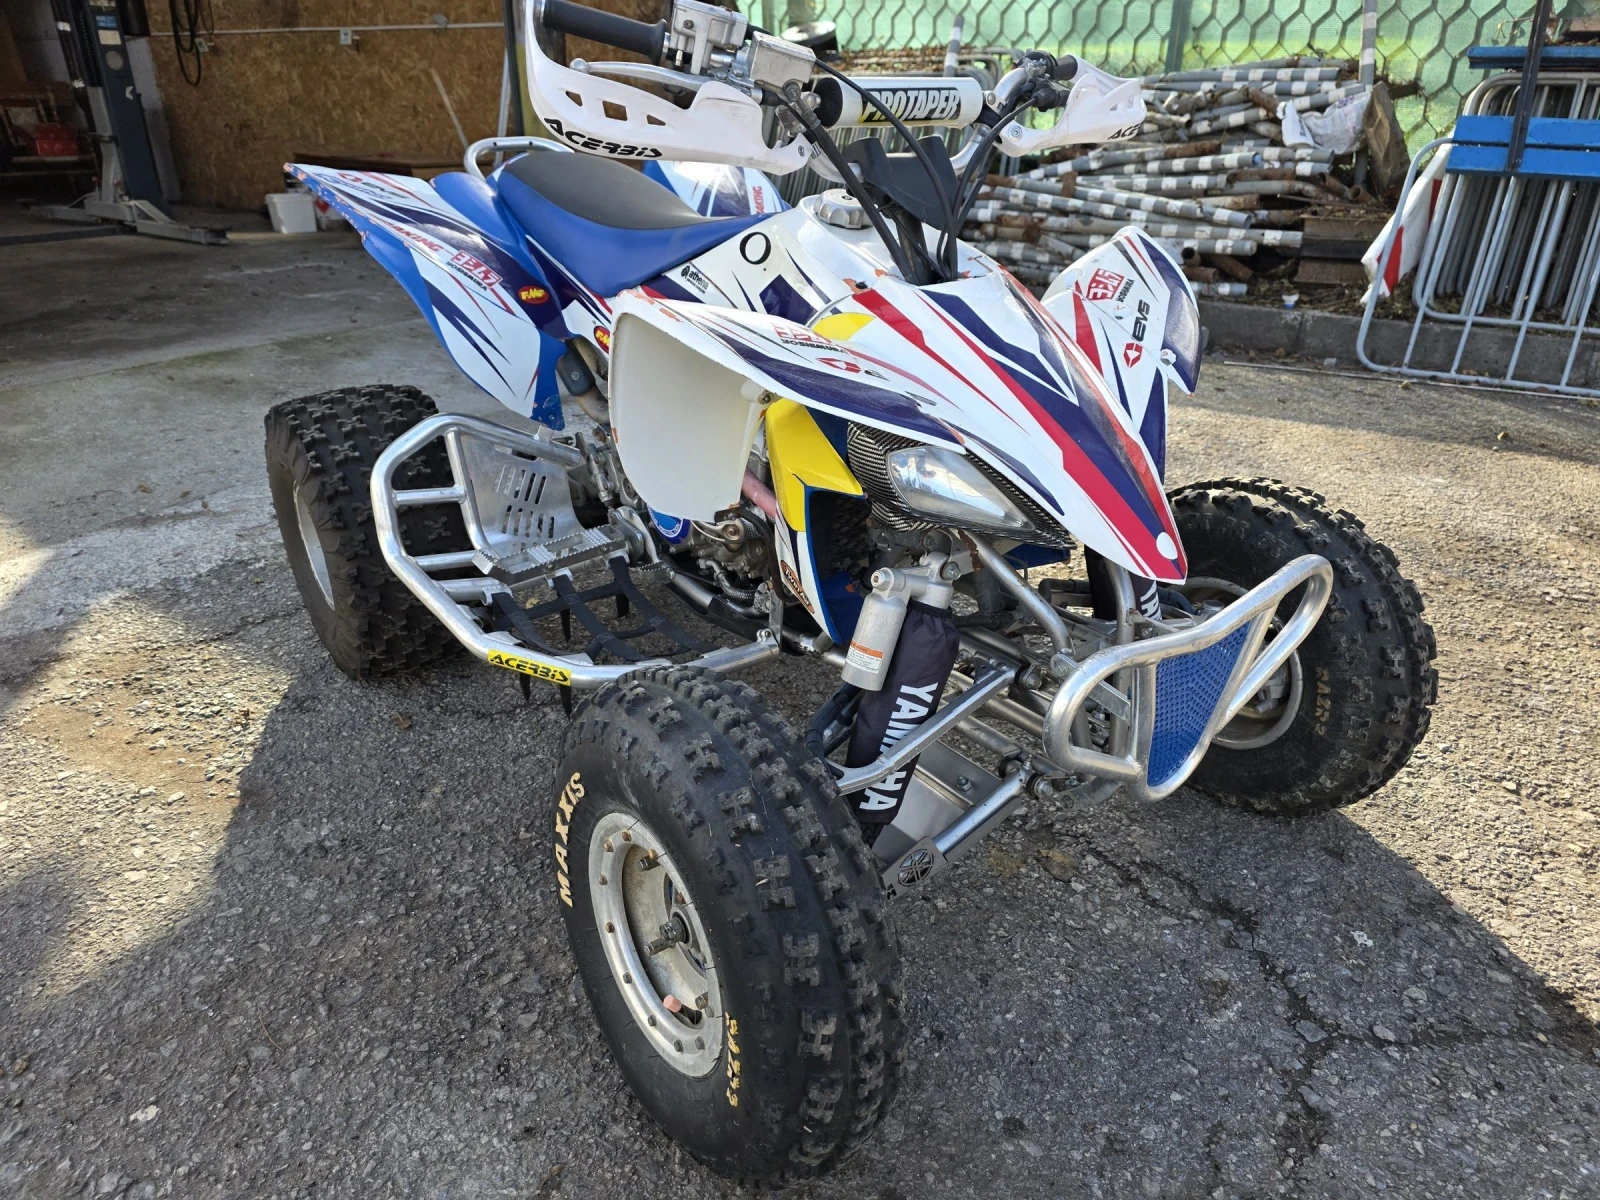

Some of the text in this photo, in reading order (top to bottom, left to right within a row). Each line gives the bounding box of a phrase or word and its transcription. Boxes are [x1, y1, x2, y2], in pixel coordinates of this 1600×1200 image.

[544, 118, 662, 157] ACERBIS
[446, 261, 487, 291] YOSHIMURA
[490, 652, 569, 683] ACERBIS
[555, 772, 585, 907] MAXXIS
